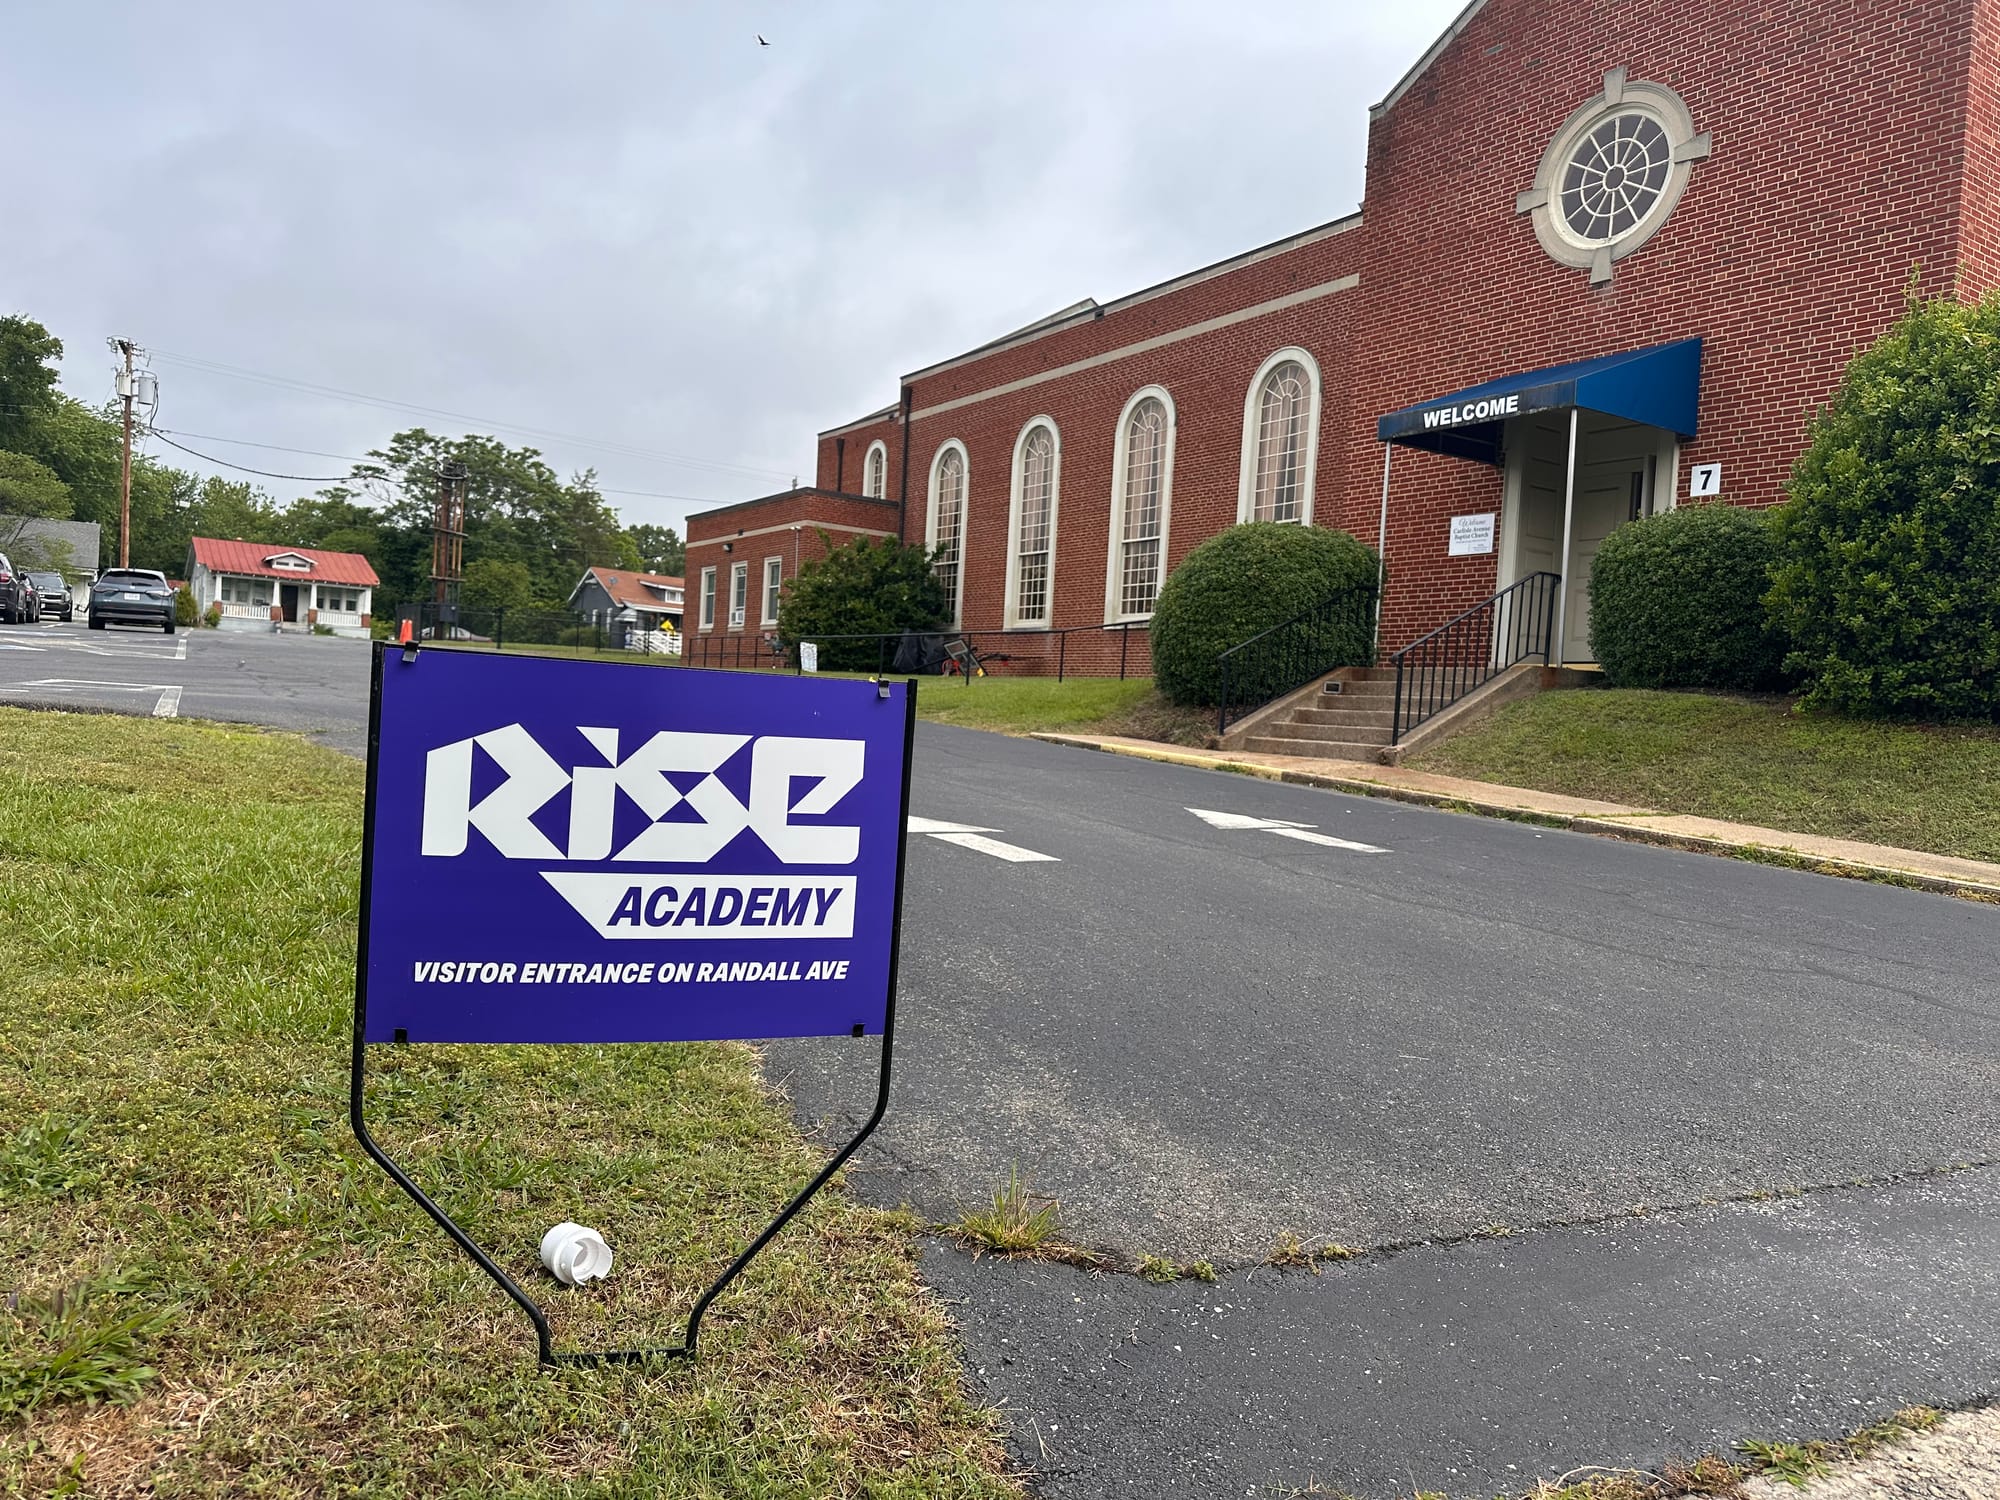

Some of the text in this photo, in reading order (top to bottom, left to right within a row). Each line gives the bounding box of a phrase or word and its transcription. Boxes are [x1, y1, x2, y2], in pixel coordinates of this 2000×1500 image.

[1423, 395, 1519, 428] WELCOME
[1700, 469, 1712, 490] 7
[606, 885, 843, 927] ACADEMY
[413, 960, 850, 984] VISITOR ENTRANCE ON RANDALL AVE
